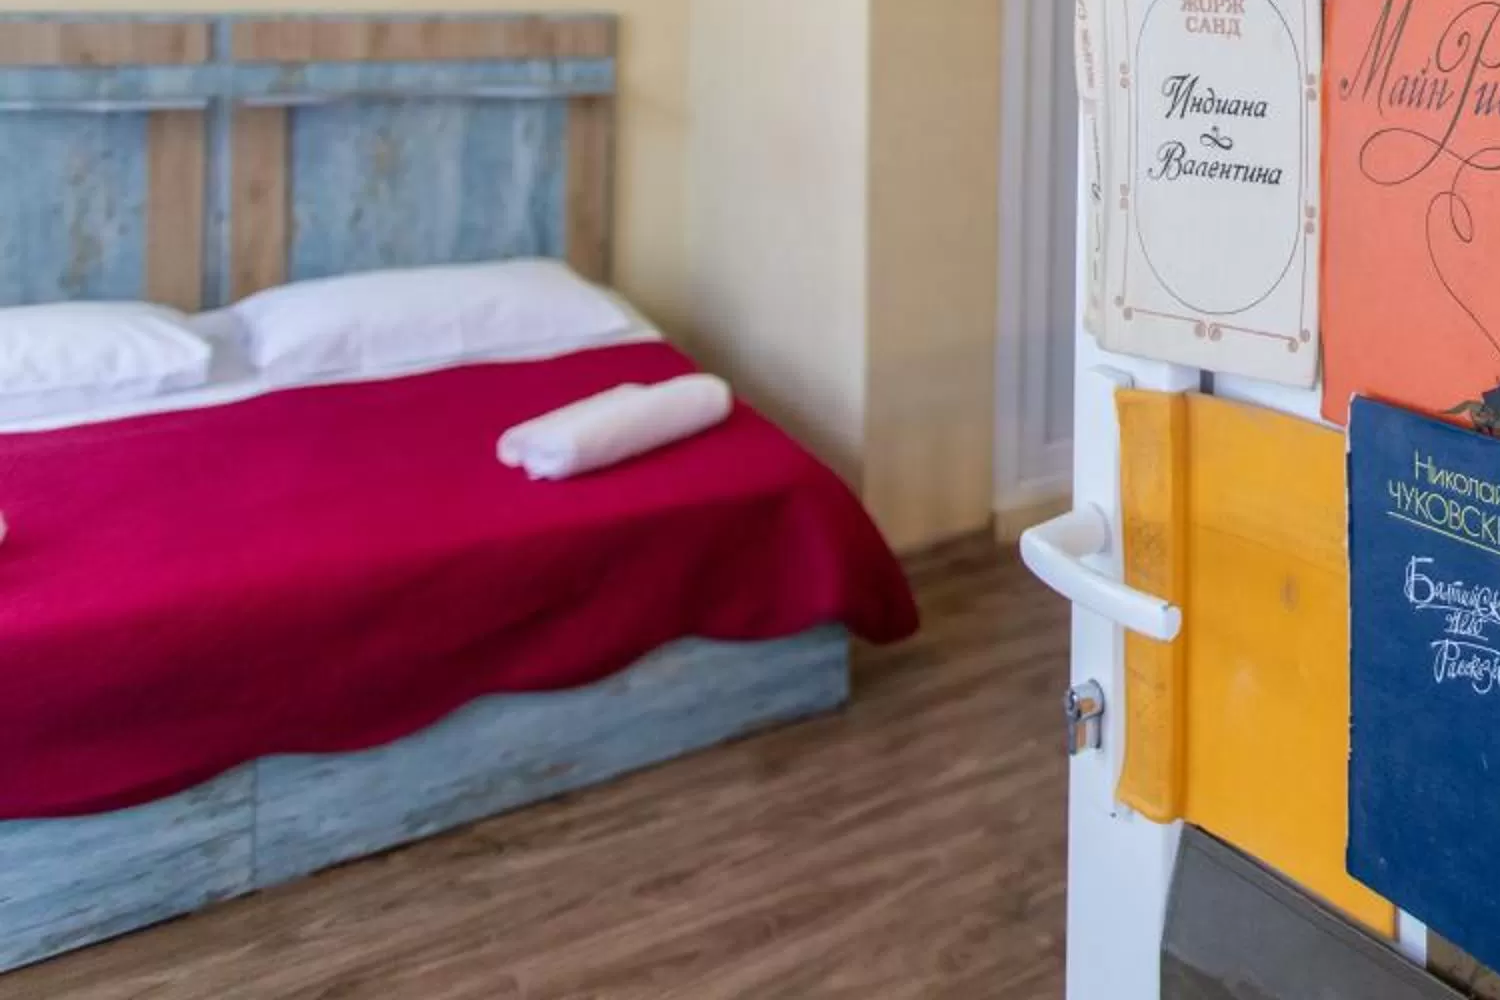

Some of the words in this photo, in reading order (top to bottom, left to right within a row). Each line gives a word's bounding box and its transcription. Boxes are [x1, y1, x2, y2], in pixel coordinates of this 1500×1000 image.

[1185, 15, 1242, 39] САНД
[1161, 73, 1269, 119] Индиана
[1148, 140, 1283, 185] Валентина
